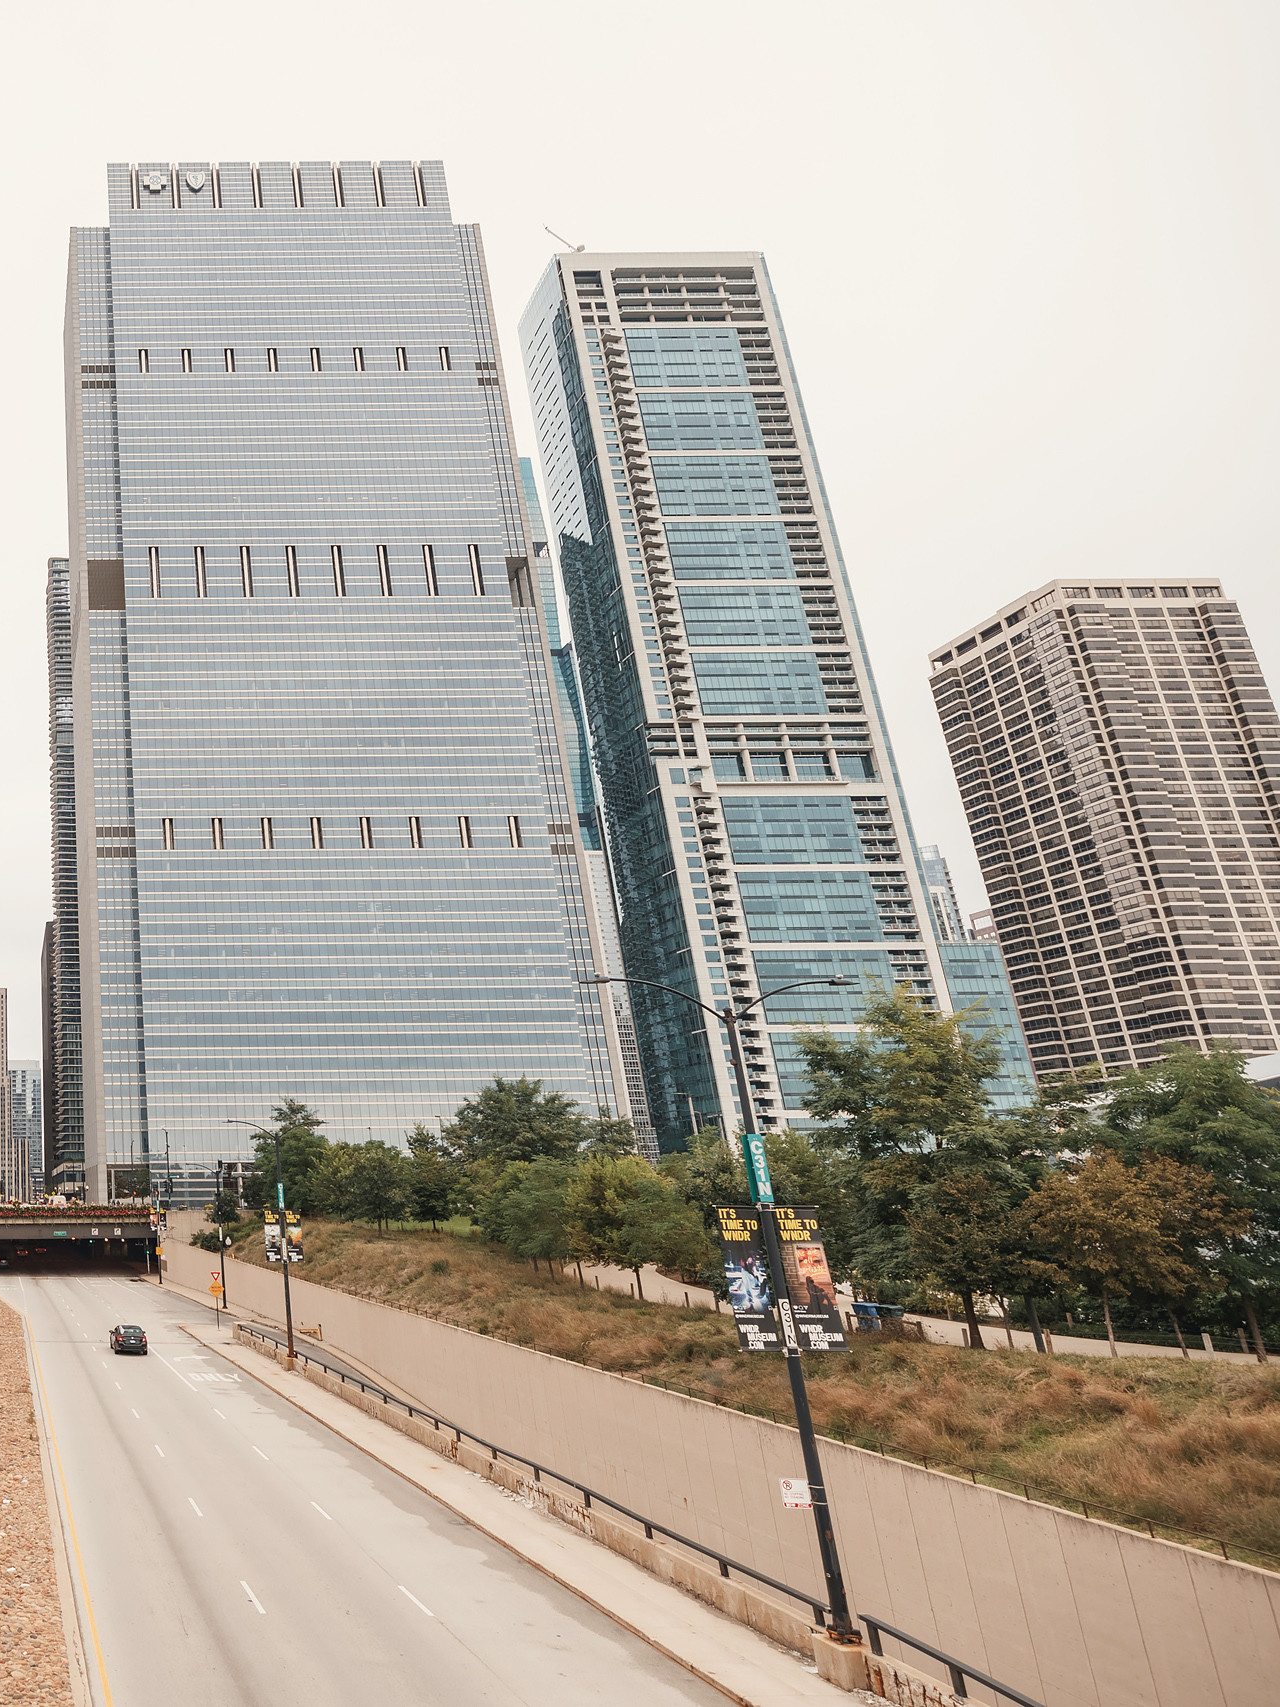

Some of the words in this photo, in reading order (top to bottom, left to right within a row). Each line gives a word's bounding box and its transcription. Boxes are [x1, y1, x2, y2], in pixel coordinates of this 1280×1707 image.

[751, 1140, 772, 1196] C31N
[718, 1208, 737, 1219] IT'S
[776, 1208, 795, 1219] IT'S
[720, 1219, 744, 1230] TIME
[745, 1219, 758, 1230] TO
[778, 1219, 803, 1230] TIME
[803, 1219, 818, 1230] TO
[722, 1230, 751, 1241] WNDR
[780, 1230, 811, 1241] WNDR
[781, 1301, 797, 1345] C31N
[738, 1324, 760, 1334] WNDR
[799, 1324, 823, 1334] WNDR
[747, 1332, 777, 1342] MUSEUM
[809, 1332, 844, 1342] MUSEUM
[748, 1341, 765, 1350] .COM
[810, 1341, 830, 1350] .COM
